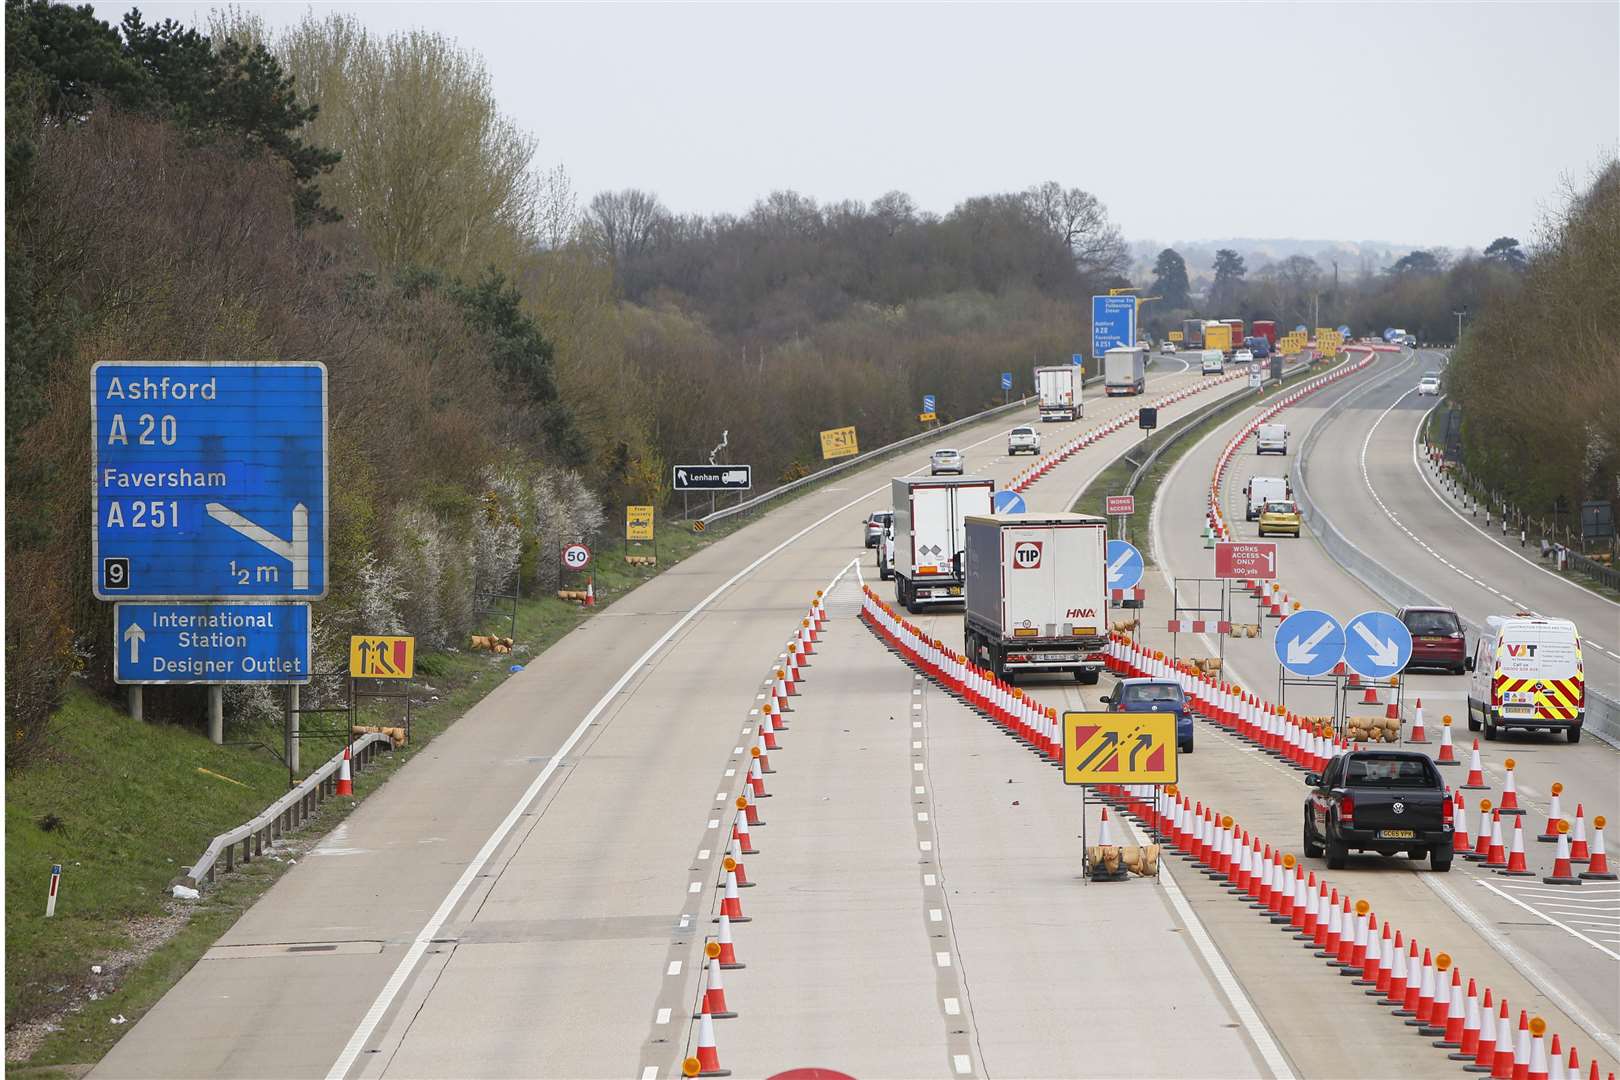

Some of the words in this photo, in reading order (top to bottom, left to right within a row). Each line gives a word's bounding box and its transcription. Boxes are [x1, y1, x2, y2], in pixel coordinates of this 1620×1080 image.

[106, 376, 217, 400] Ashford
[104, 468, 226, 488] Faversham
[690, 473, 720, 482] Lenham
[567, 551, 586, 562] 50
[1017, 550, 1039, 563] TIP
[110, 563, 123, 583] 9
[152, 611, 274, 628] International
[1066, 608, 1096, 619] HNA
[178, 632, 247, 648] Station
[153, 656, 234, 677] Designer
[241, 656, 301, 673] Outlet
